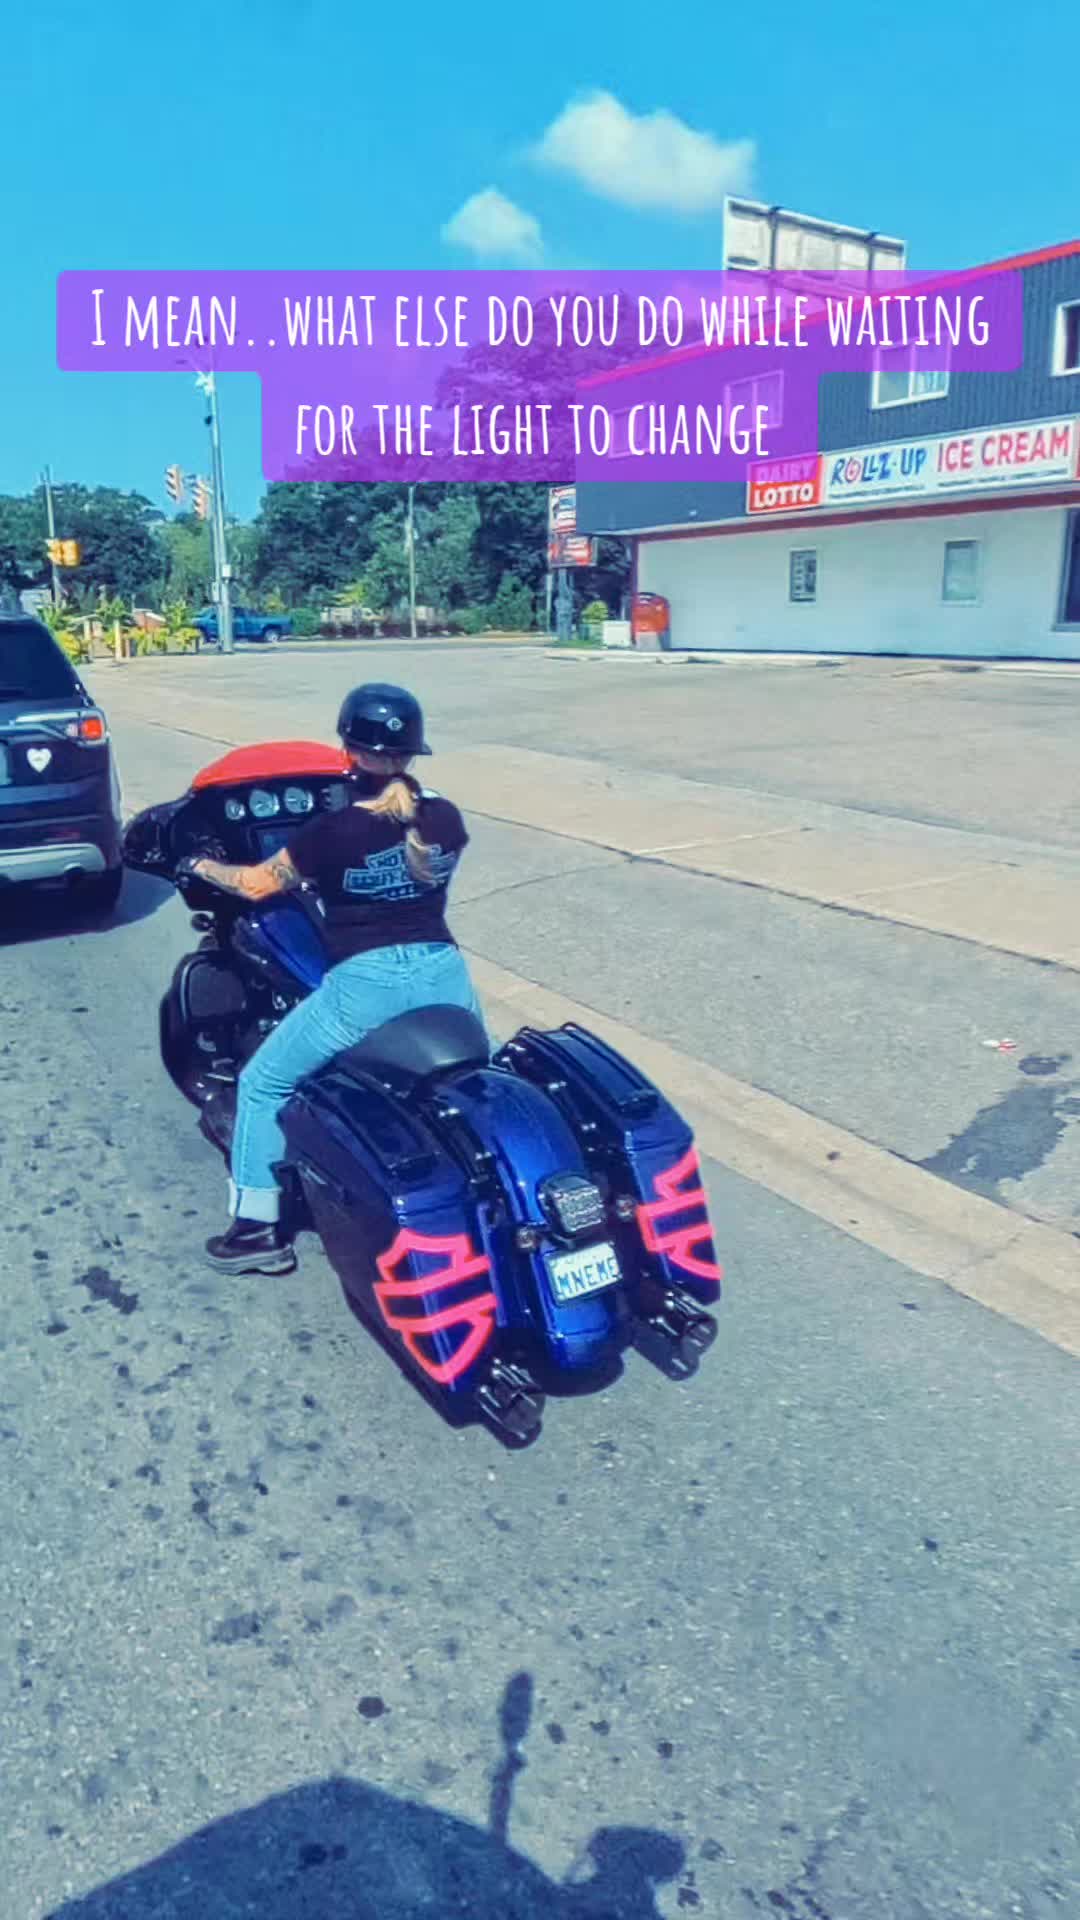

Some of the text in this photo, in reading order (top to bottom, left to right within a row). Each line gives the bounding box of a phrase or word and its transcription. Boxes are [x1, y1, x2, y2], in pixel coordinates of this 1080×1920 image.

[937, 439, 974, 472] ICE
[981, 425, 1070, 467] CREAM
[754, 483, 813, 508] LOTTO
